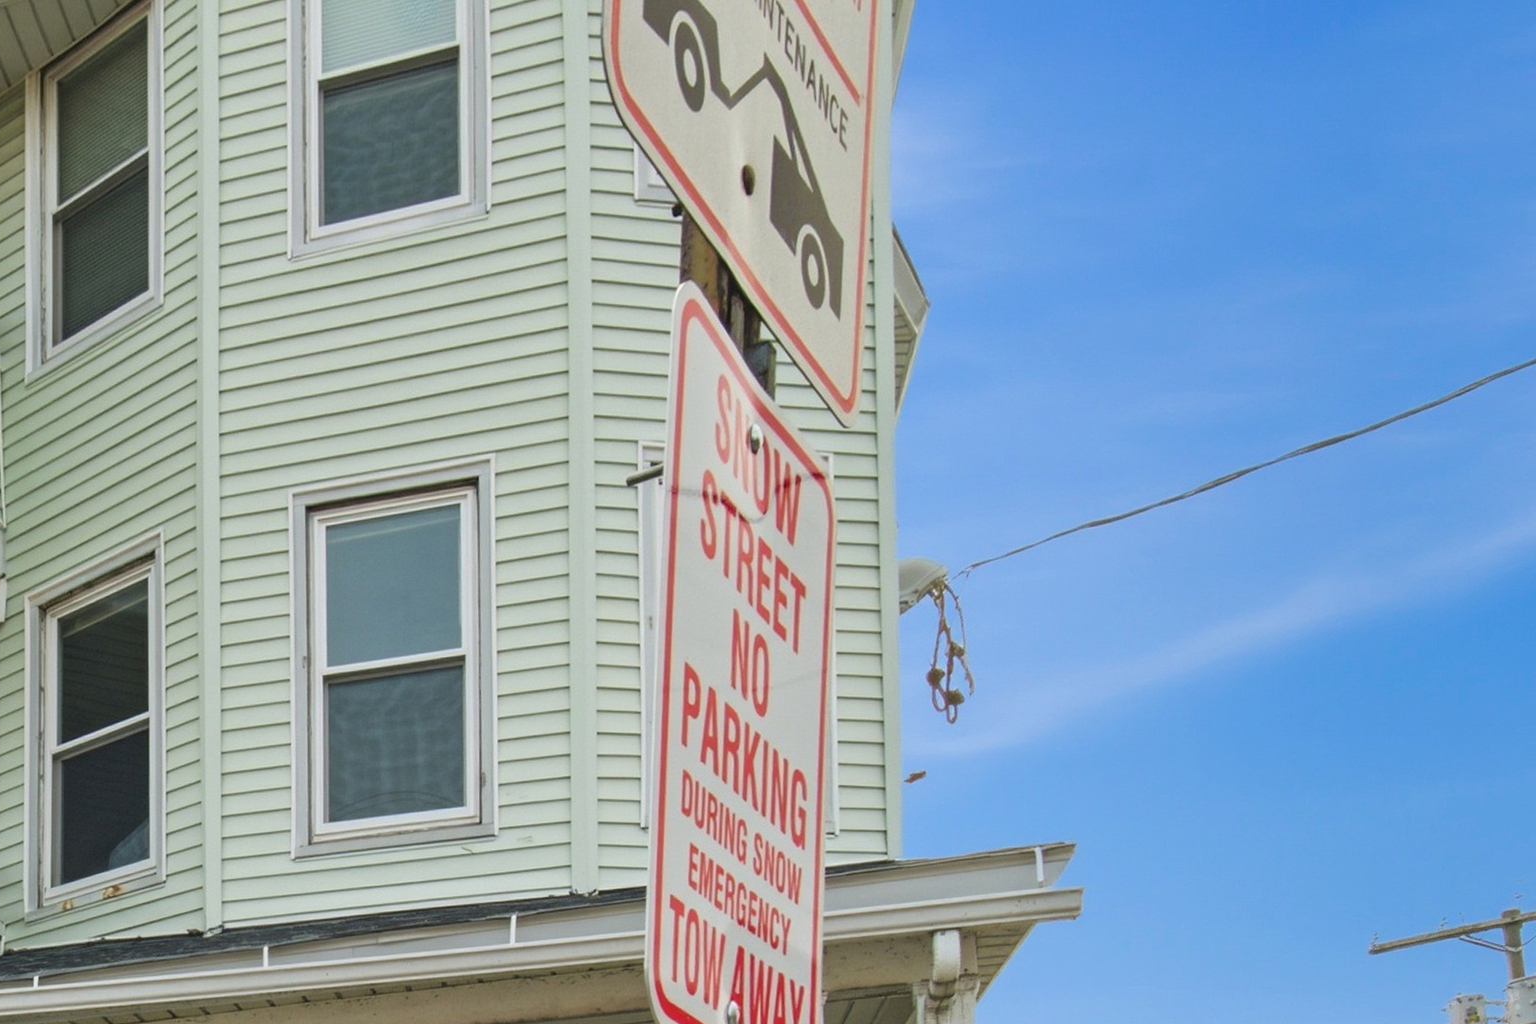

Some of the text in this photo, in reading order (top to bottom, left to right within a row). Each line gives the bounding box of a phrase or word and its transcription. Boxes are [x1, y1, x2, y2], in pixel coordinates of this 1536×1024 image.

[754, 0, 848, 151] NTENANCE
[715, 373, 802, 546] SNOW
[700, 468, 806, 655] STREET
[730, 607, 770, 718] NO
[681, 661, 807, 850] PARKING
[681, 769, 802, 905] DURING SNOW
[688, 842, 791, 956] EMERGENCY
[669, 894, 726, 1011] TOW
